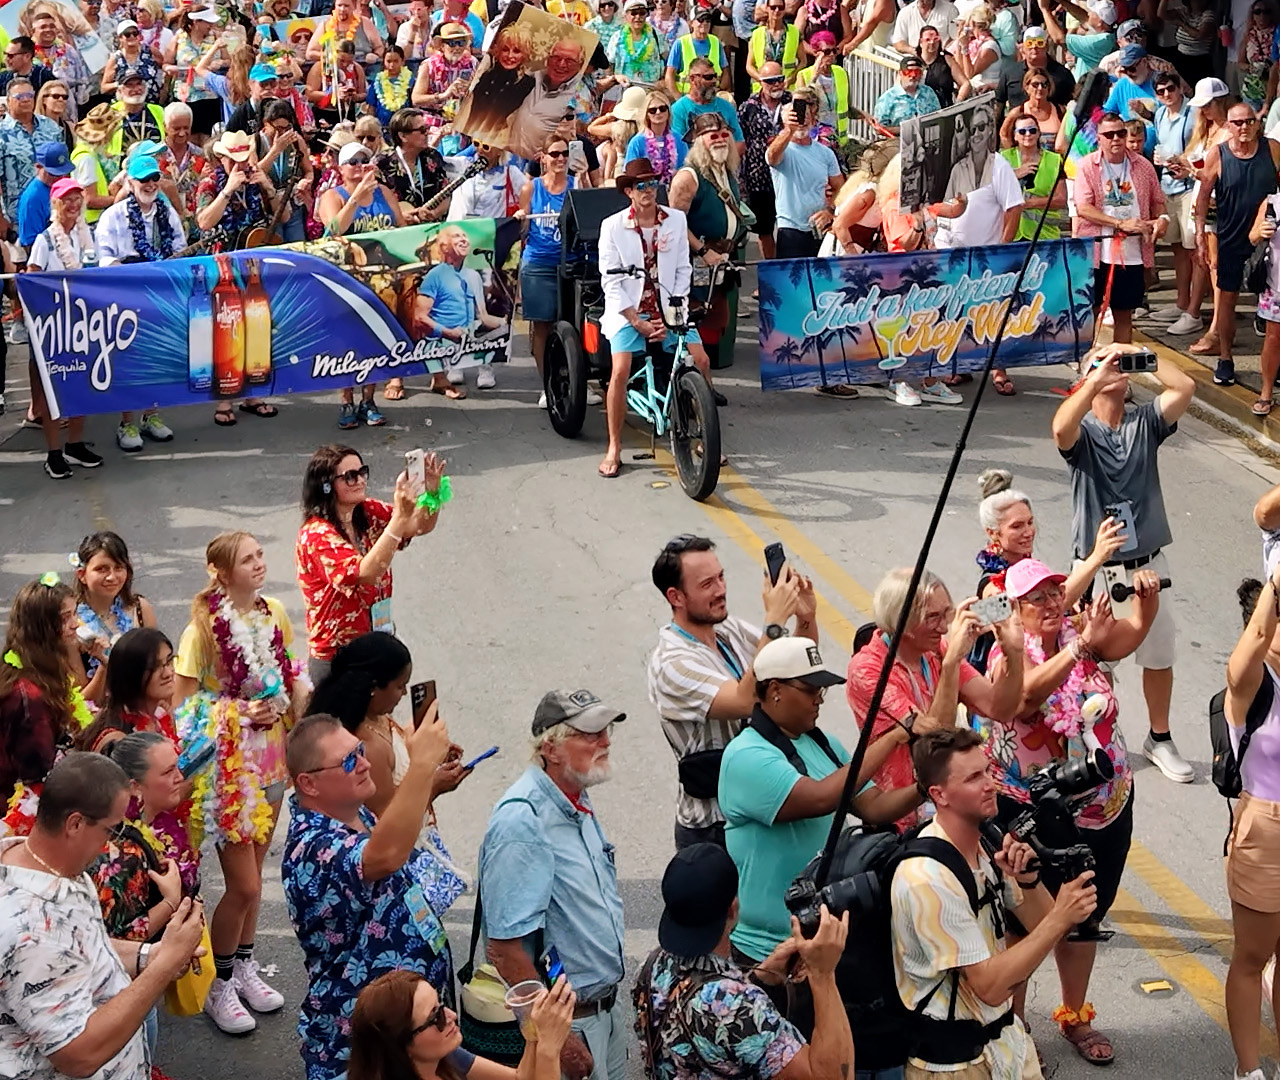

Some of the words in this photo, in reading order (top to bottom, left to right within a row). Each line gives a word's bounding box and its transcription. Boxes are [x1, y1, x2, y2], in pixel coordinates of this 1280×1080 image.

[33, 277, 138, 391] milagro
[803, 285, 881, 336] Just
[876, 294, 902, 320] a
[900, 283, 953, 321] few
[312, 350, 389, 383] Milagro
[389, 340, 454, 367] Salutes
[900, 310, 968, 365] Key
[46, 358, 87, 381] Tequila
